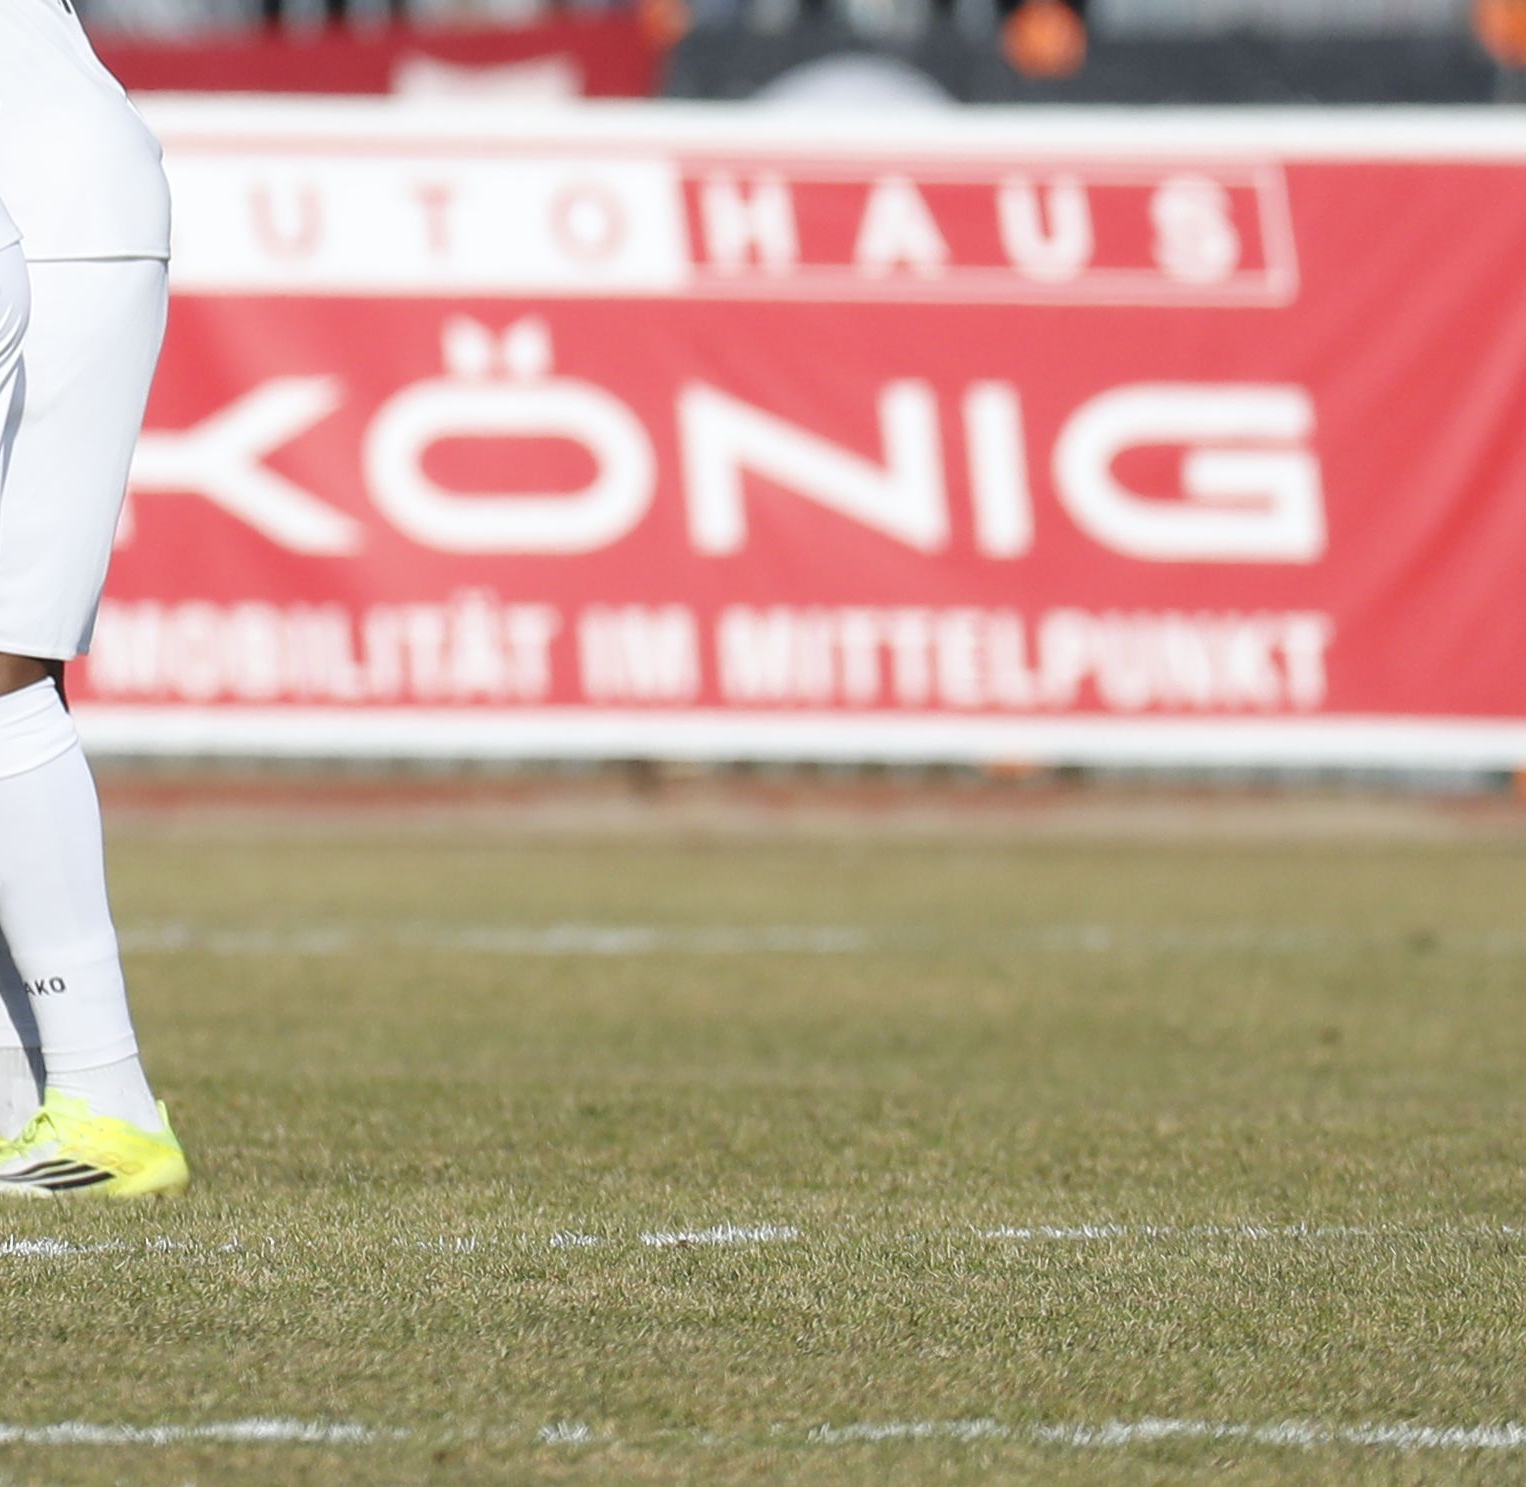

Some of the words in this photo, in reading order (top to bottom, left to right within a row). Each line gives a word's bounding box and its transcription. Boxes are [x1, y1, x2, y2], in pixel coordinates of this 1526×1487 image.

[116, 312, 1328, 566] KÖNIG
[86, 585, 564, 704] MOBILITÄT
[575, 600, 703, 708] IM
[714, 602, 1334, 711] MITTELPUNKT
[24, 976, 67, 996] AKO
